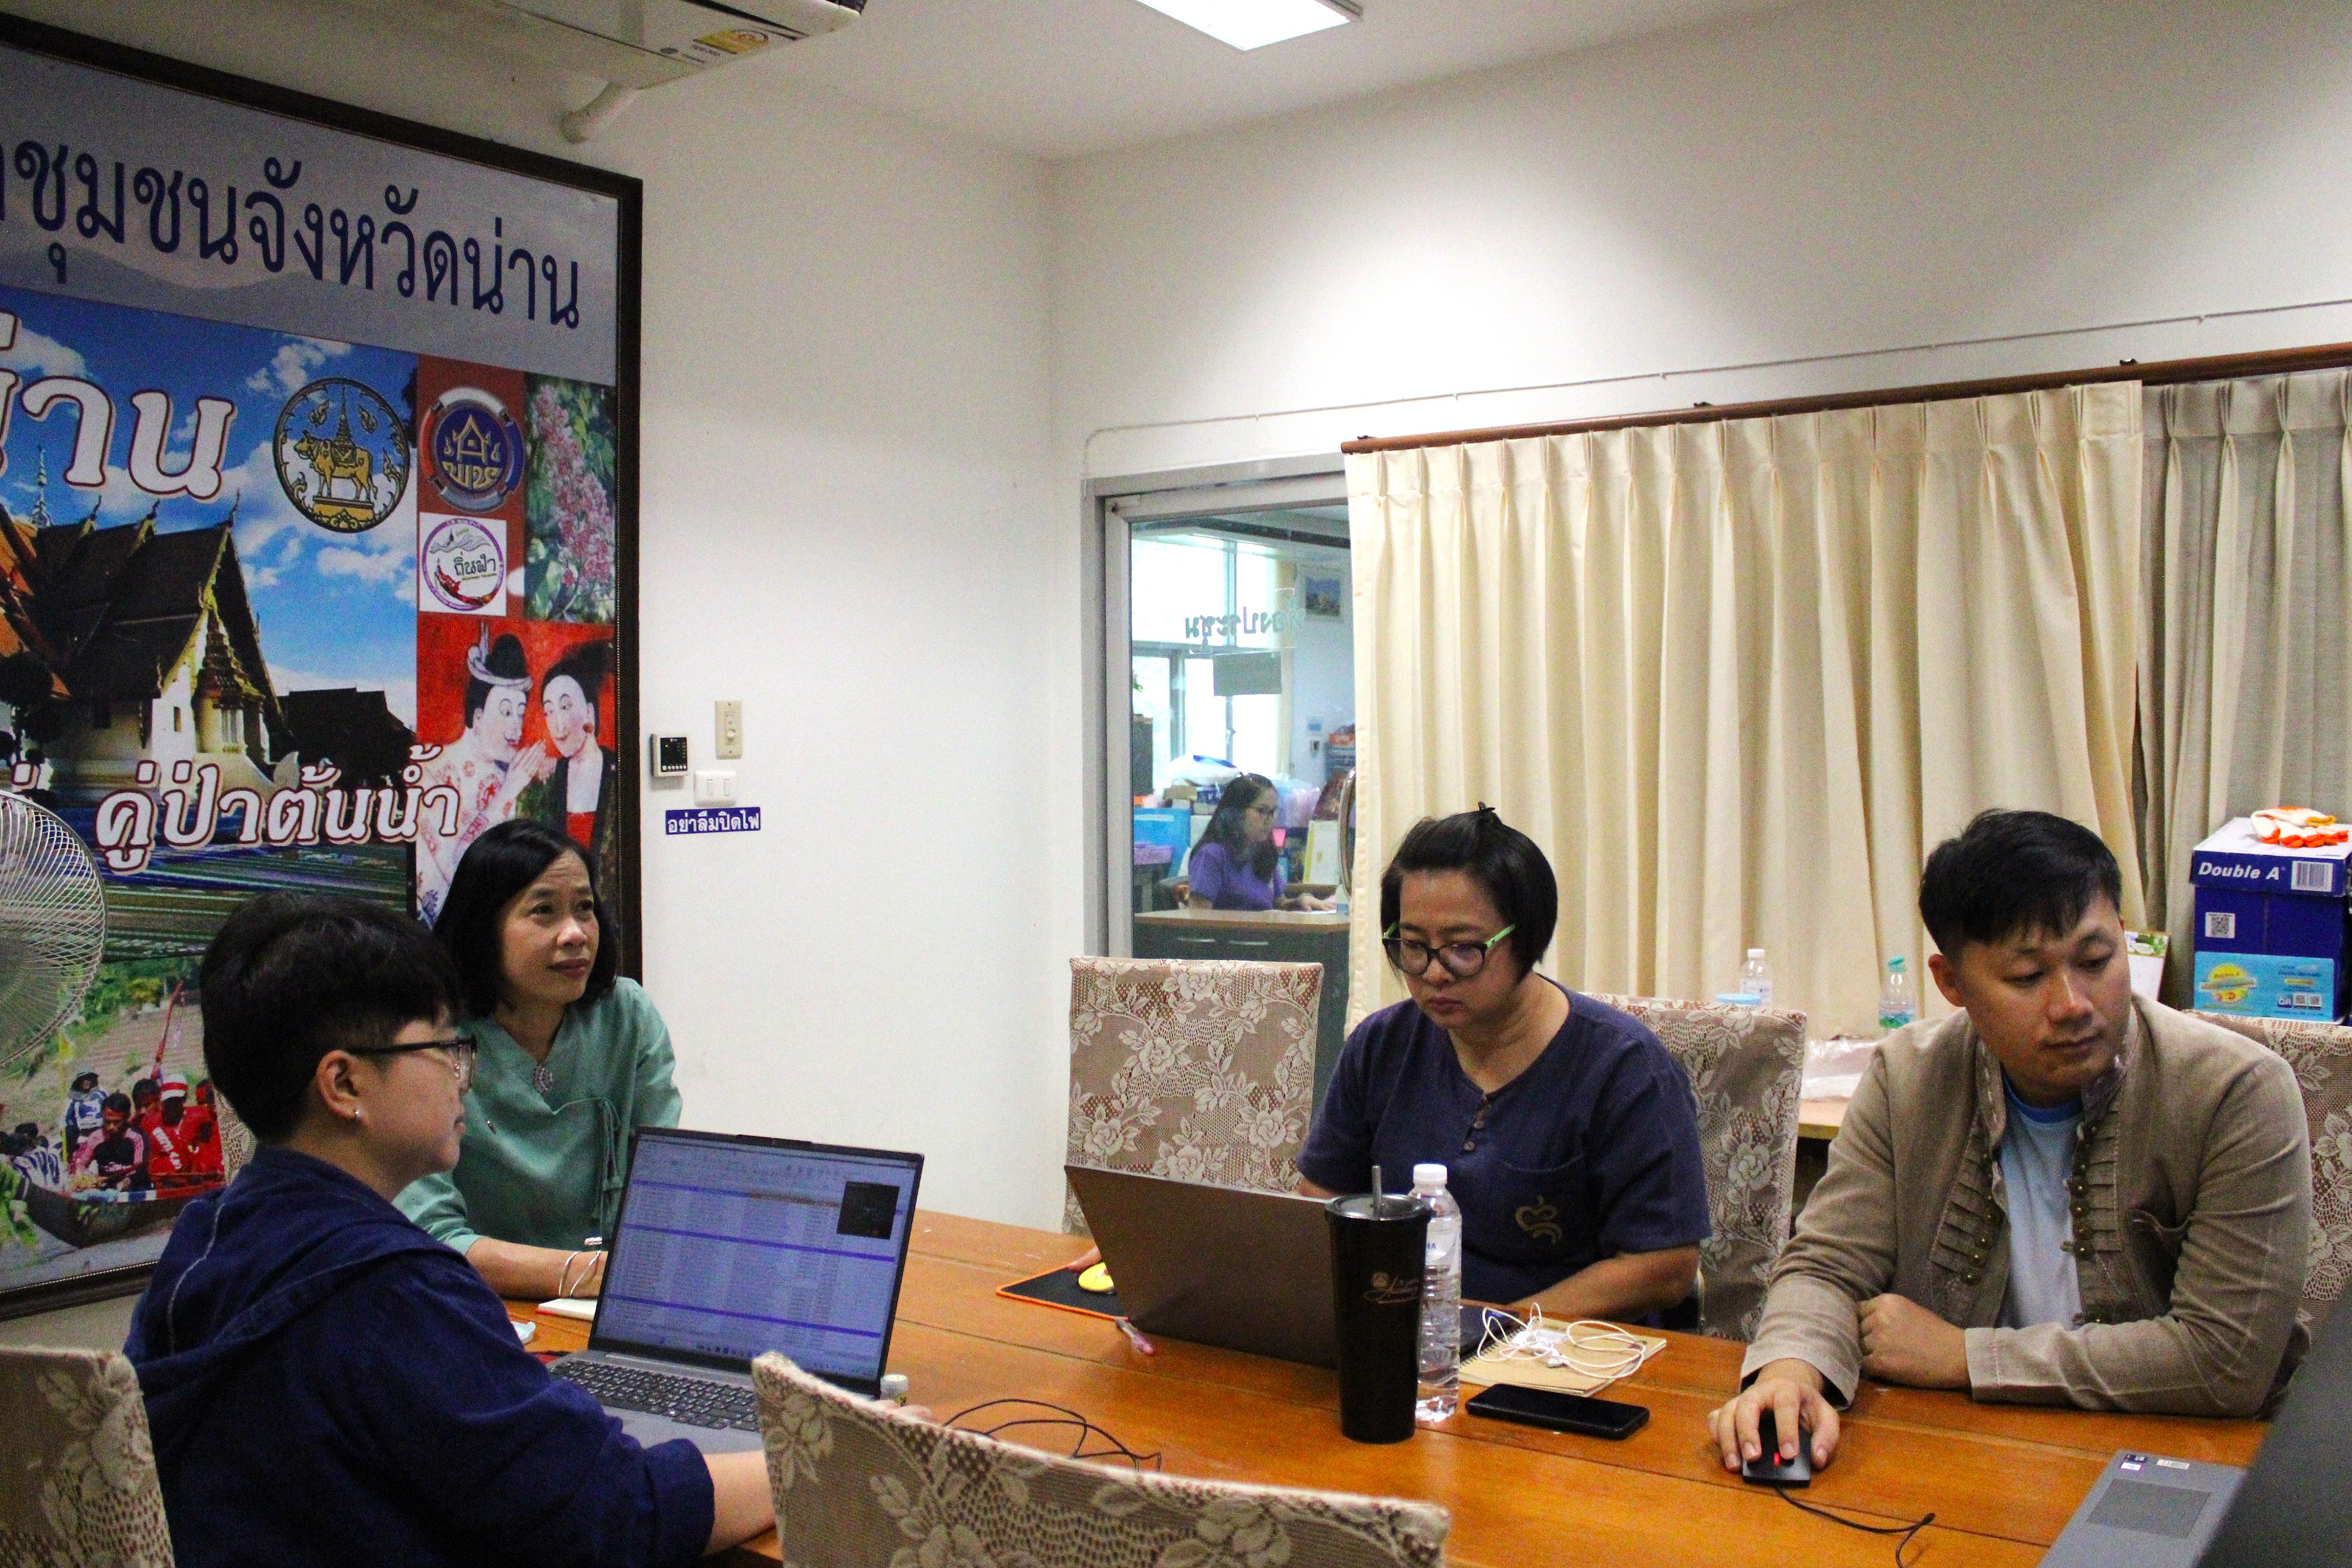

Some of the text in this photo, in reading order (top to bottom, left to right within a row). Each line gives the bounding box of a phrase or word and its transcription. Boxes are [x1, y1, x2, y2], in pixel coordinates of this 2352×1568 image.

[0, 141, 579, 329] ชุมชนจังหวัดน่าน
[667, 810, 759, 833] อย่าลืมปิดไฟ
[2198, 862, 2280, 880] Double A
